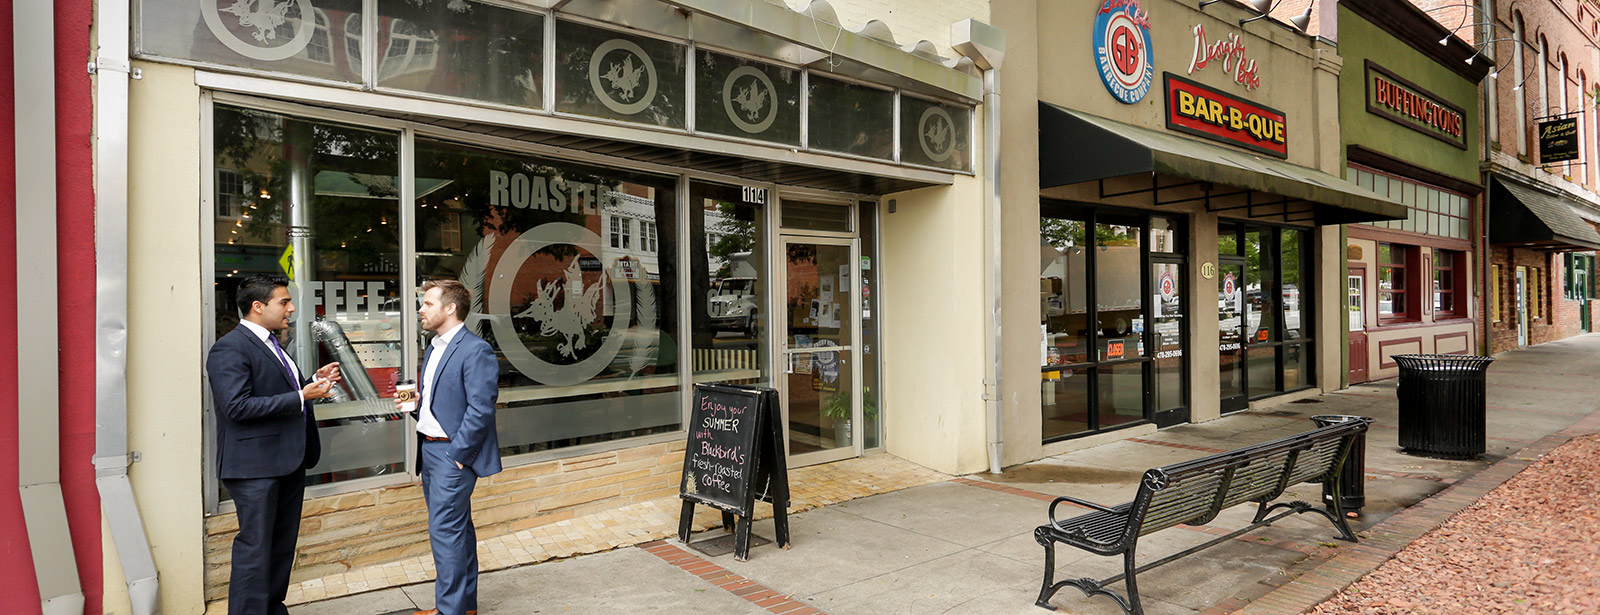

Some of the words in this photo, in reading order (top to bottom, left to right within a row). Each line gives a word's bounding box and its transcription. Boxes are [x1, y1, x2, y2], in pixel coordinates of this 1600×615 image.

[1098, 46, 1130, 102] BARBECUE
[1129, 62, 1153, 103] COMPANY
[1176, 88, 1285, 145] BAR-B-QUE
[1540, 122, 1575, 139] Asian
[743, 186, 765, 204] 114
[1202, 264, 1214, 277] 116
[1107, 342, 1124, 358] CLOSED
[701, 395, 728, 419] Enjoy
[728, 405, 748, 420] your
[702, 417, 740, 433] SUMMER
[695, 429, 714, 440] with
[701, 441, 745, 465] Blackbird's
[692, 453, 743, 479] fresh-roasted
